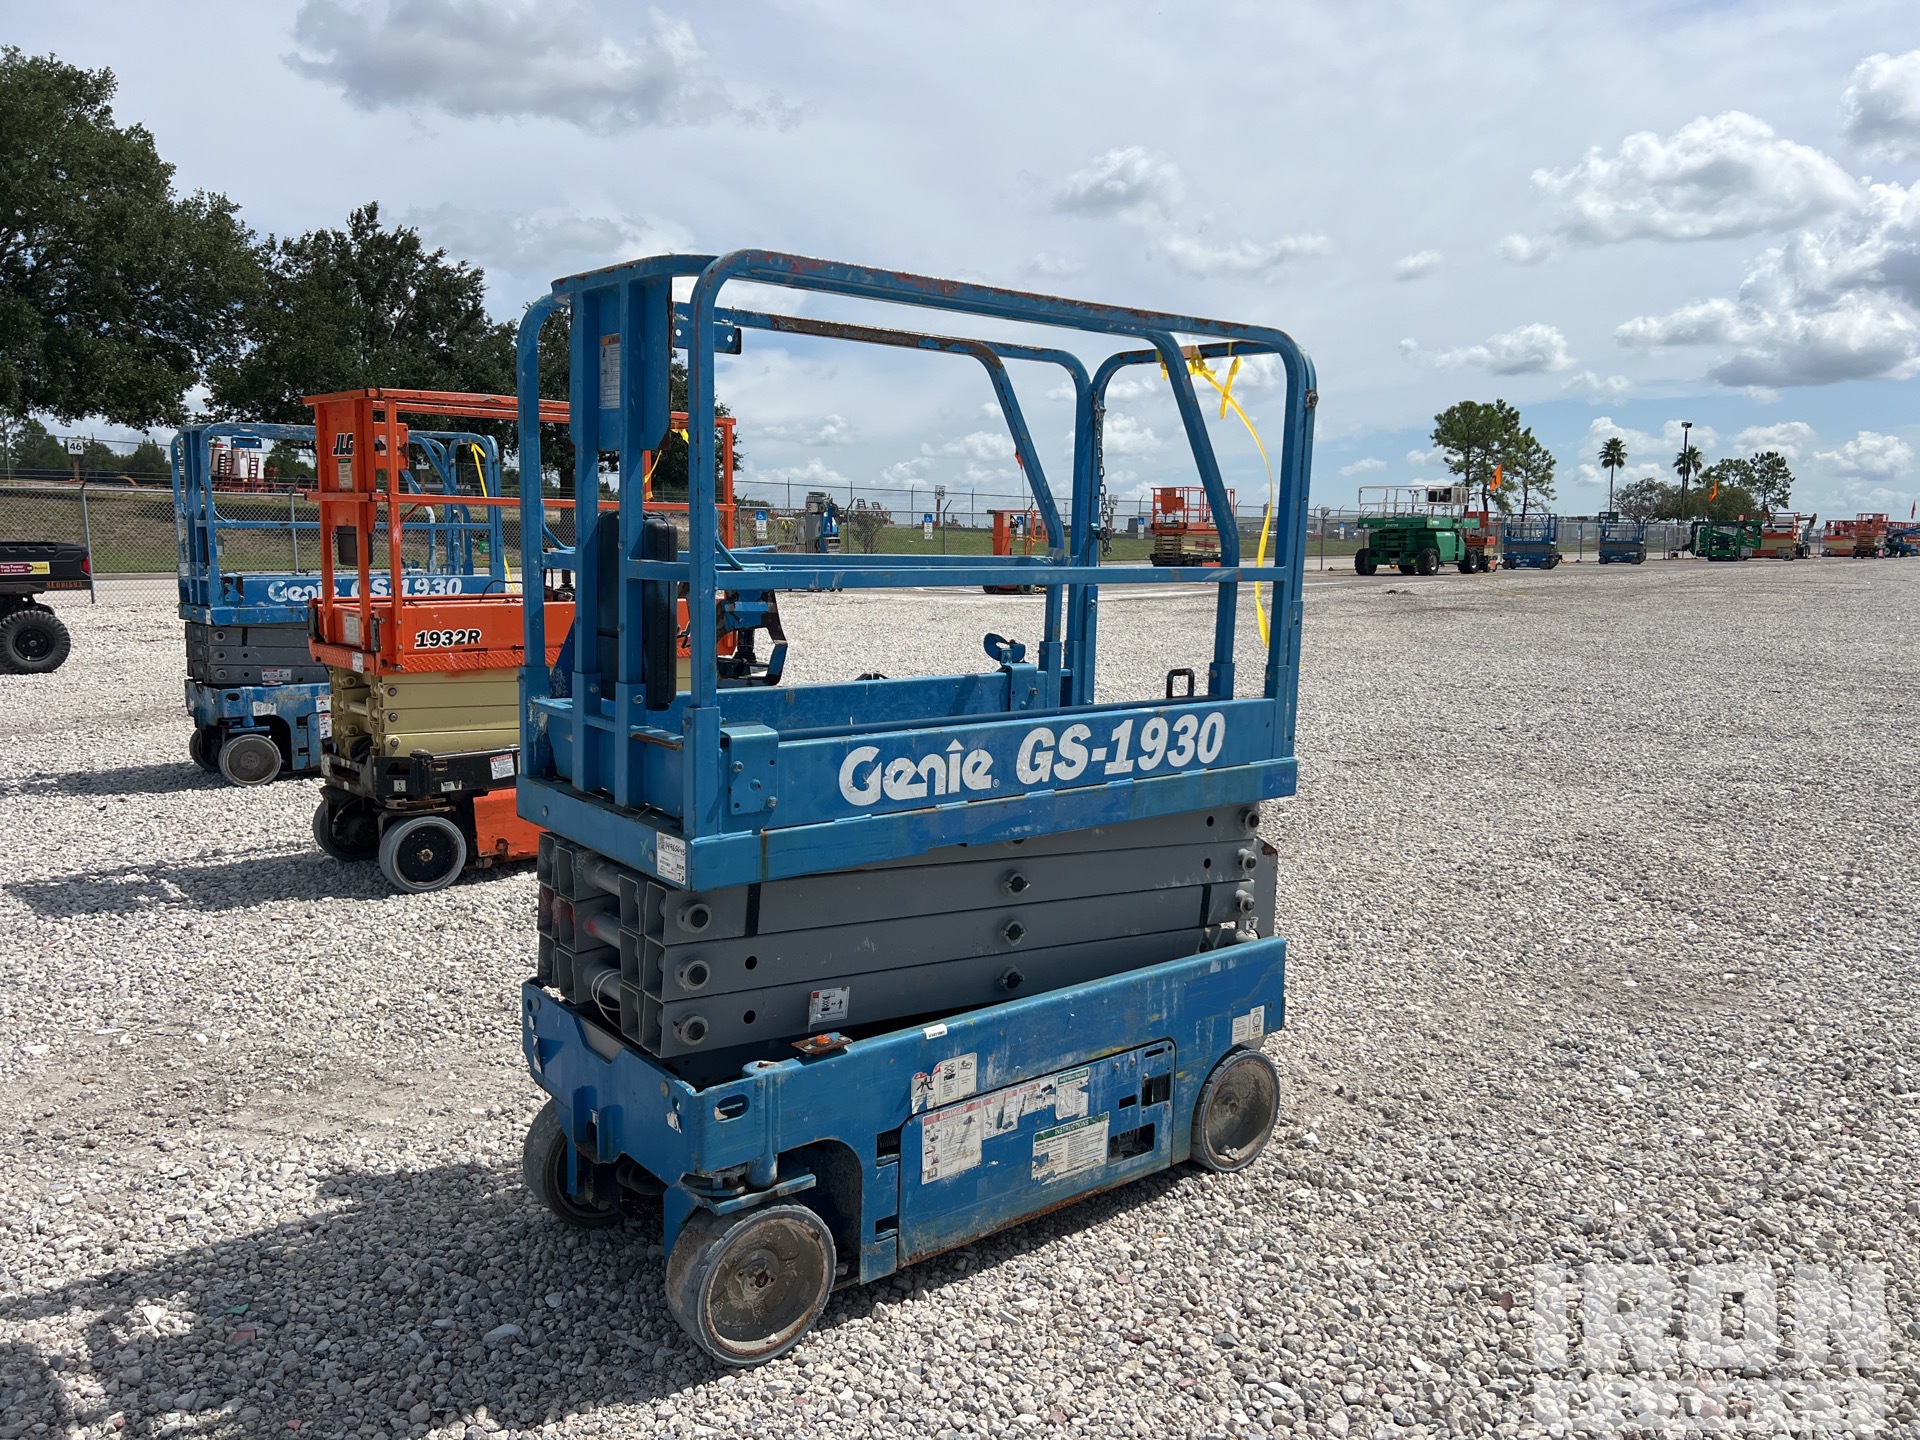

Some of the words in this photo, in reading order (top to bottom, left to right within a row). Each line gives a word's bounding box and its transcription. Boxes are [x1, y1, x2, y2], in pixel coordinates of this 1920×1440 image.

[70, 443, 82, 451] 46
[415, 629, 481, 649] 1932R
[838, 738, 994, 806] Genie
[1016, 712, 1225, 785] GS-1930
[1054, 1119, 1089, 1136] INSTRUCTIONS
